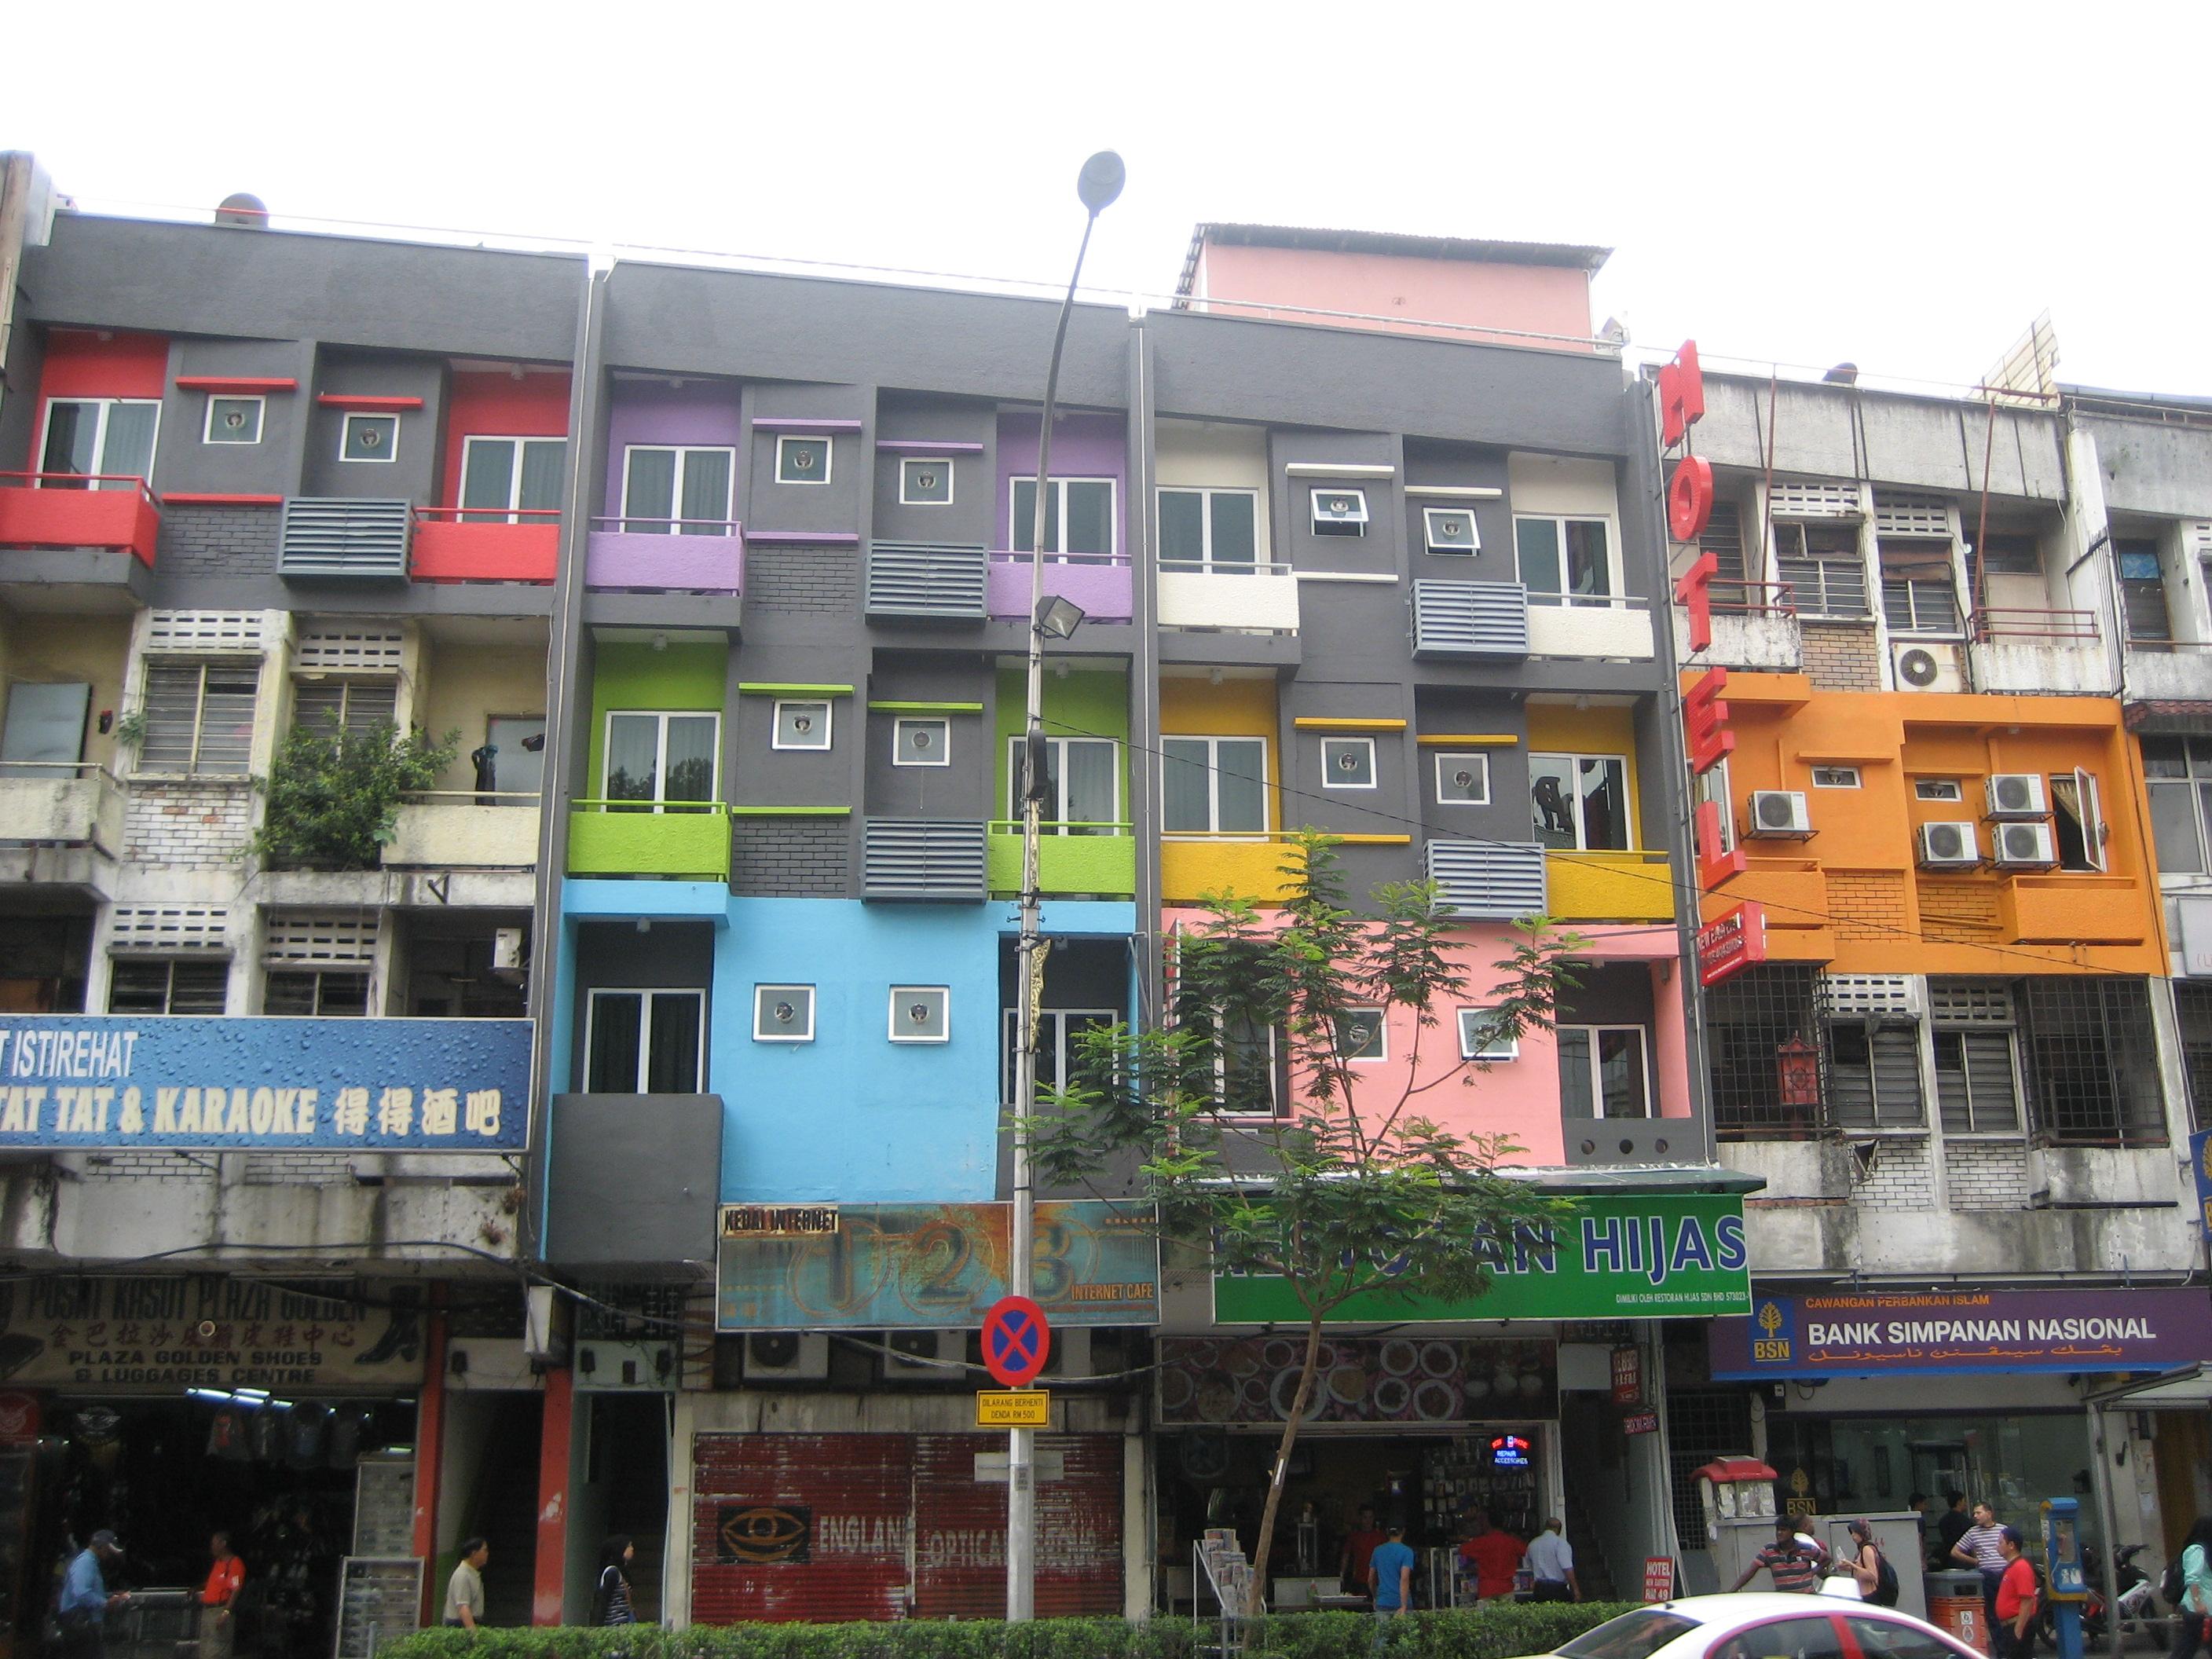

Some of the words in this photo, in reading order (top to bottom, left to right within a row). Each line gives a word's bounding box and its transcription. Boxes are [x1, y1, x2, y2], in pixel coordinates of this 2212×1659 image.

[1658, 339, 1746, 890] HOTEL
[12, 1030, 138, 1077] ISTIREHAT
[0, 1086, 47, 1132] AT
[54, 1087, 115, 1133] TAT
[119, 1087, 144, 1133] &
[153, 1087, 318, 1134] KARAOKE
[334, 1086, 502, 1136] 得得酒吧
[765, 1210, 837, 1231] INTERNET
[1580, 1214, 1749, 1286] HIJAS
[1071, 1284, 1125, 1301] INTERNET
[1126, 1283, 1154, 1299] CAFE
[1639, 1294, 1654, 1302] OLEH
[1654, 1293, 1683, 1302] RESTORAN
[1684, 1292, 1700, 1302] HIJAS
[1701, 1292, 1712, 1301] SDN
[1713, 1292, 1725, 1301] BHD
[1806, 1298, 1875, 1308] CAWANGAN
[1877, 1296, 1951, 1308] PERBANKAN
[1953, 1295, 1990, 1306] ISLAM
[1808, 1322, 1882, 1346] BANK
[1887, 1319, 2022, 1344] SIMPANAN
[2027, 1317, 2158, 1341] NASIONAL
[69, 1351, 143, 1365] PLAZA
[155, 1351, 240, 1364] GOLDEN
[251, 1351, 322, 1365] SHOES
[1753, 1342, 1791, 1360] BSN
[102, 1368, 220, 1382] LUGGAGES
[231, 1368, 316, 1382] CENTRE
[982, 1398, 1013, 1407] DILARANG
[1015, 1398, 1044, 1407] BERHENTI
[991, 1410, 1011, 1419] DENDA
[1787, 1501, 1816, 1515] BSN
[1646, 1561, 1671, 1577] HOTEL
[1657, 1588, 1668, 1601] 49
